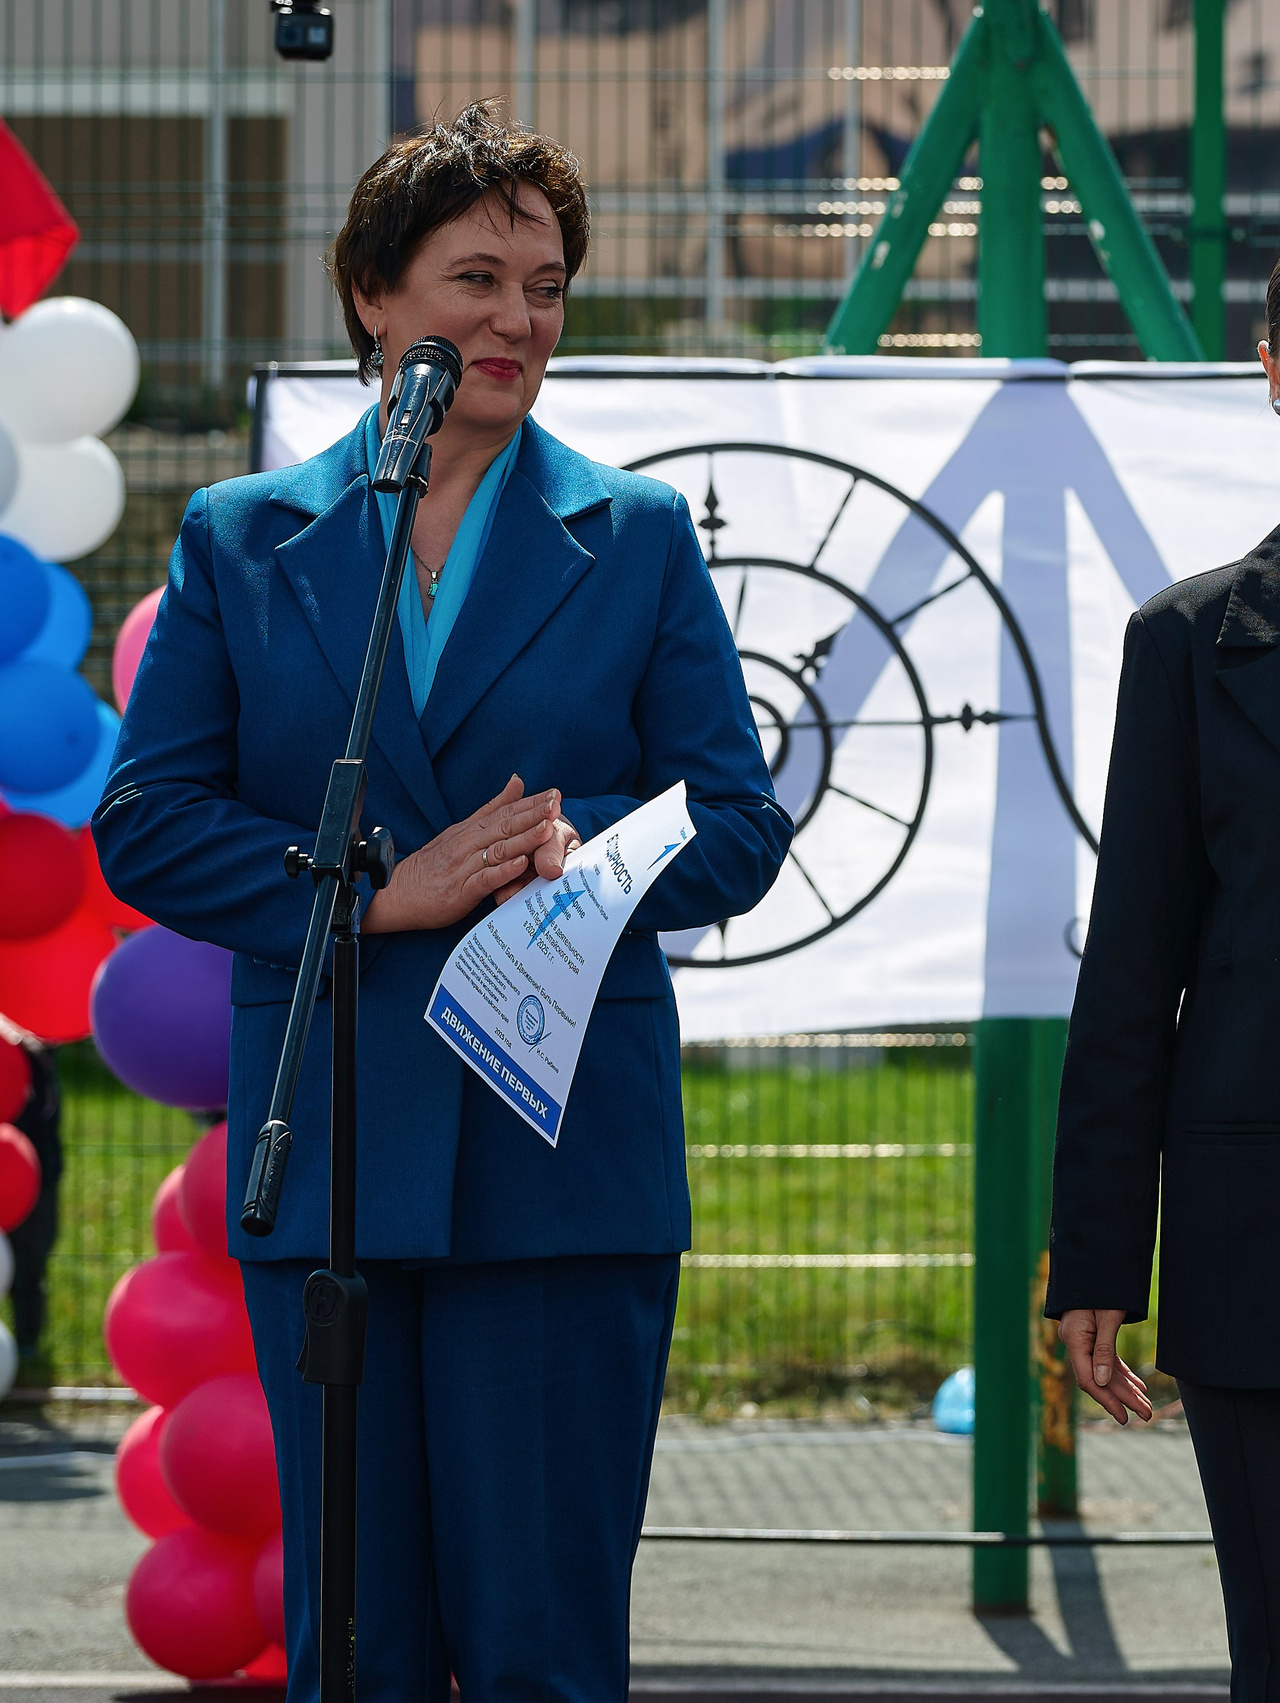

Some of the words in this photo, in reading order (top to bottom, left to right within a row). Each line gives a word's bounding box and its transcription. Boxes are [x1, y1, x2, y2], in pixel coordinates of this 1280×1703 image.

[536, 937, 549, 956] 2025
[544, 930, 569, 963] Алтайского
[567, 960, 580, 976] края
[555, 928, 585, 965] деятельности
[540, 988, 553, 1005] Быть
[552, 1000, 577, 1029] Первыми!
[494, 1026, 505, 1041] 2025
[440, 1006, 502, 1074] ДВИЖЕНИЕ
[500, 1065, 549, 1120] ПЕРВЫХ
